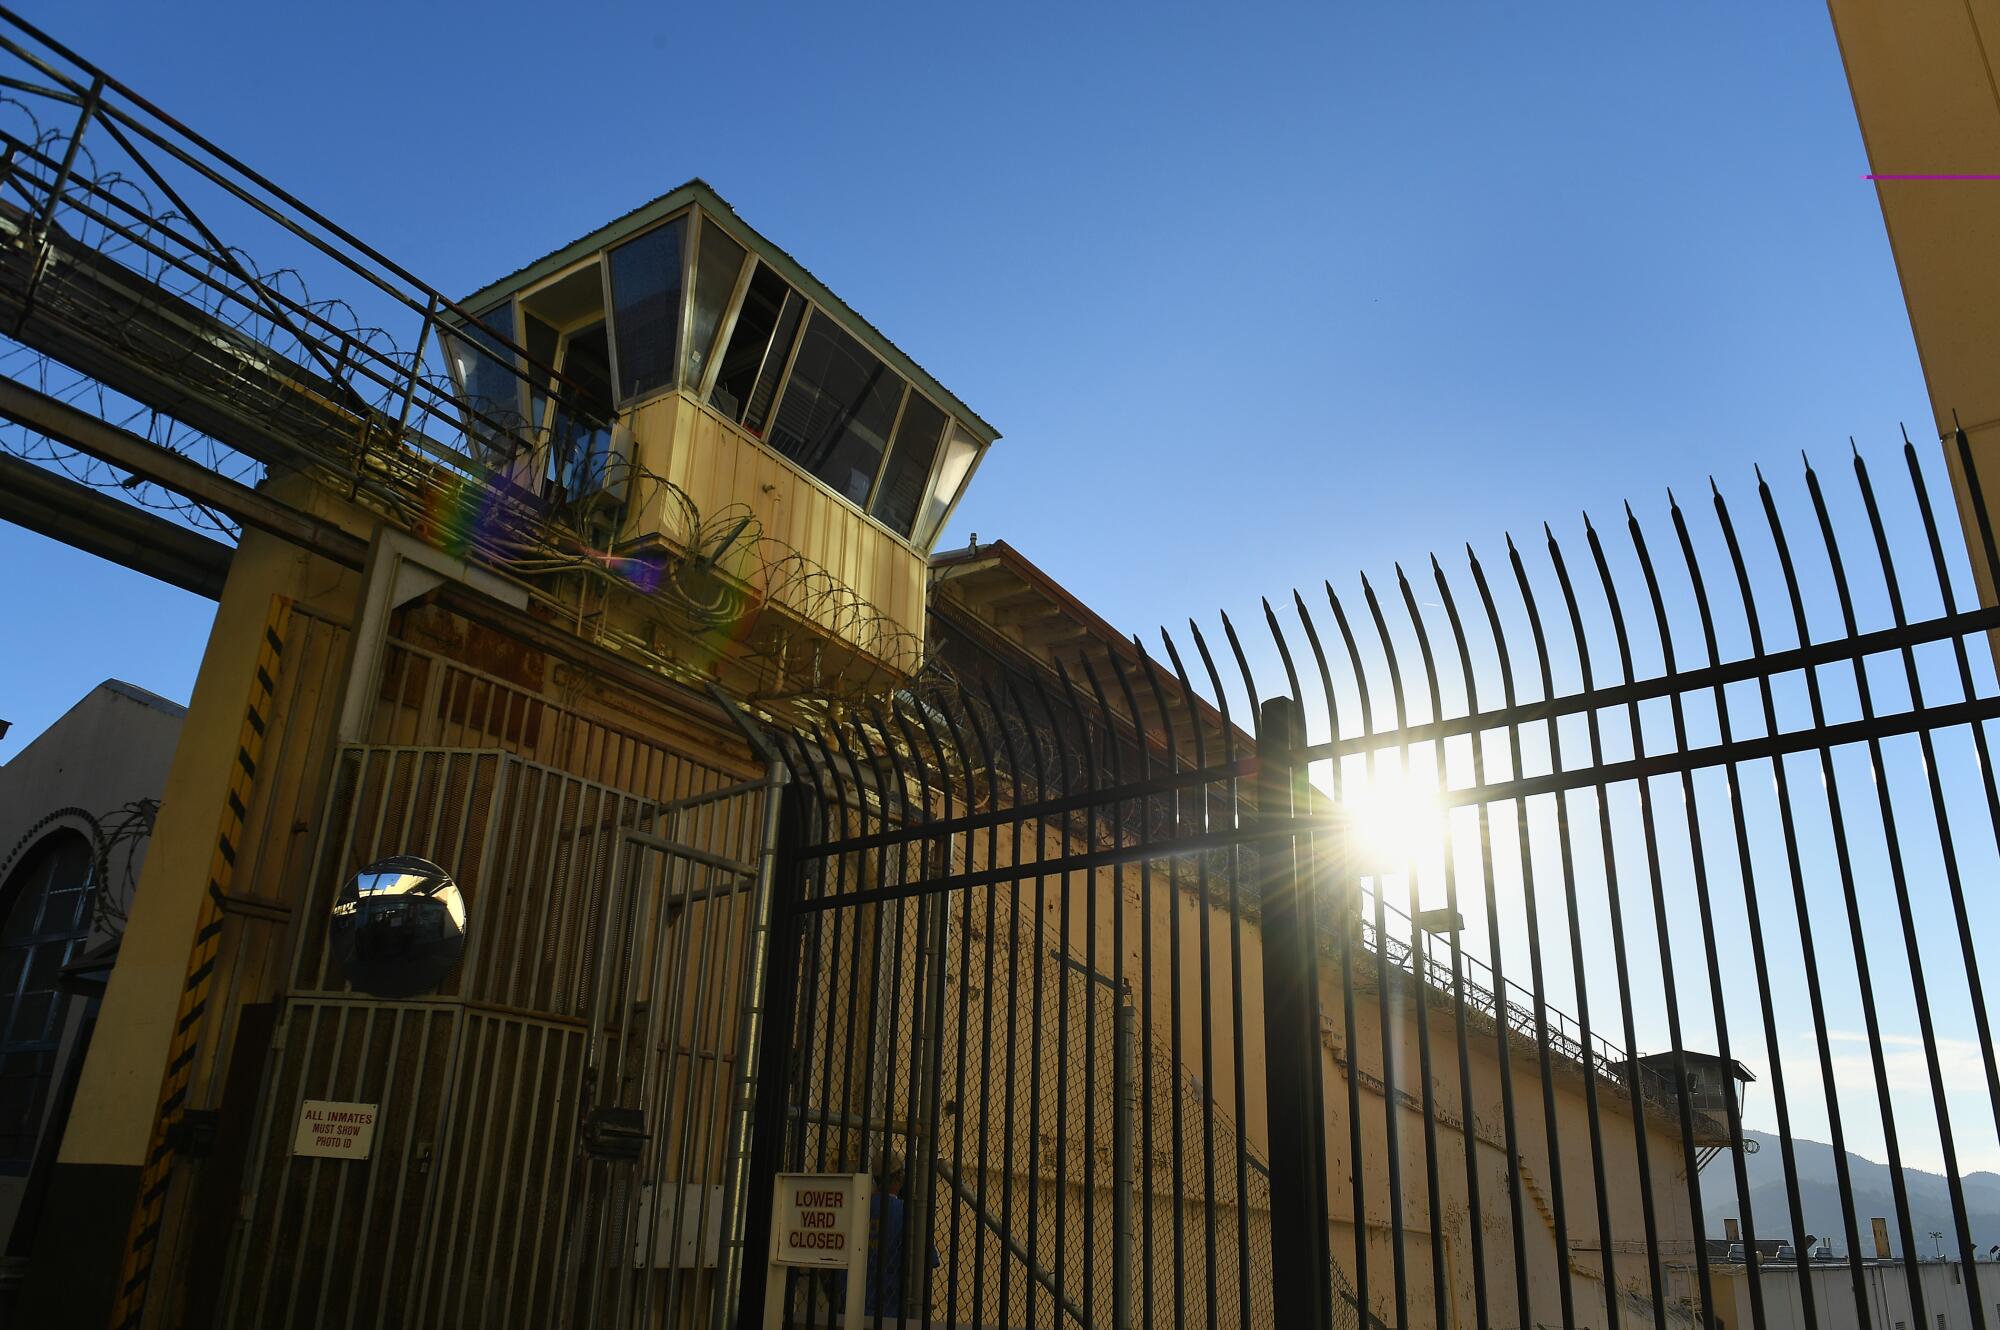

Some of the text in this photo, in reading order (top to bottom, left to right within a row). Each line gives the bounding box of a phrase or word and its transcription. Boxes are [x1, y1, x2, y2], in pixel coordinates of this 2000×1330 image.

[305, 1110, 373, 1124] ALL INMATES
[312, 1123, 361, 1136] MUST SHOW
[315, 1136, 352, 1148] PHOTO ID
[795, 1191, 843, 1208] LOWER
[801, 1211, 835, 1228] YARD
[789, 1232, 844, 1250] CLOSED
